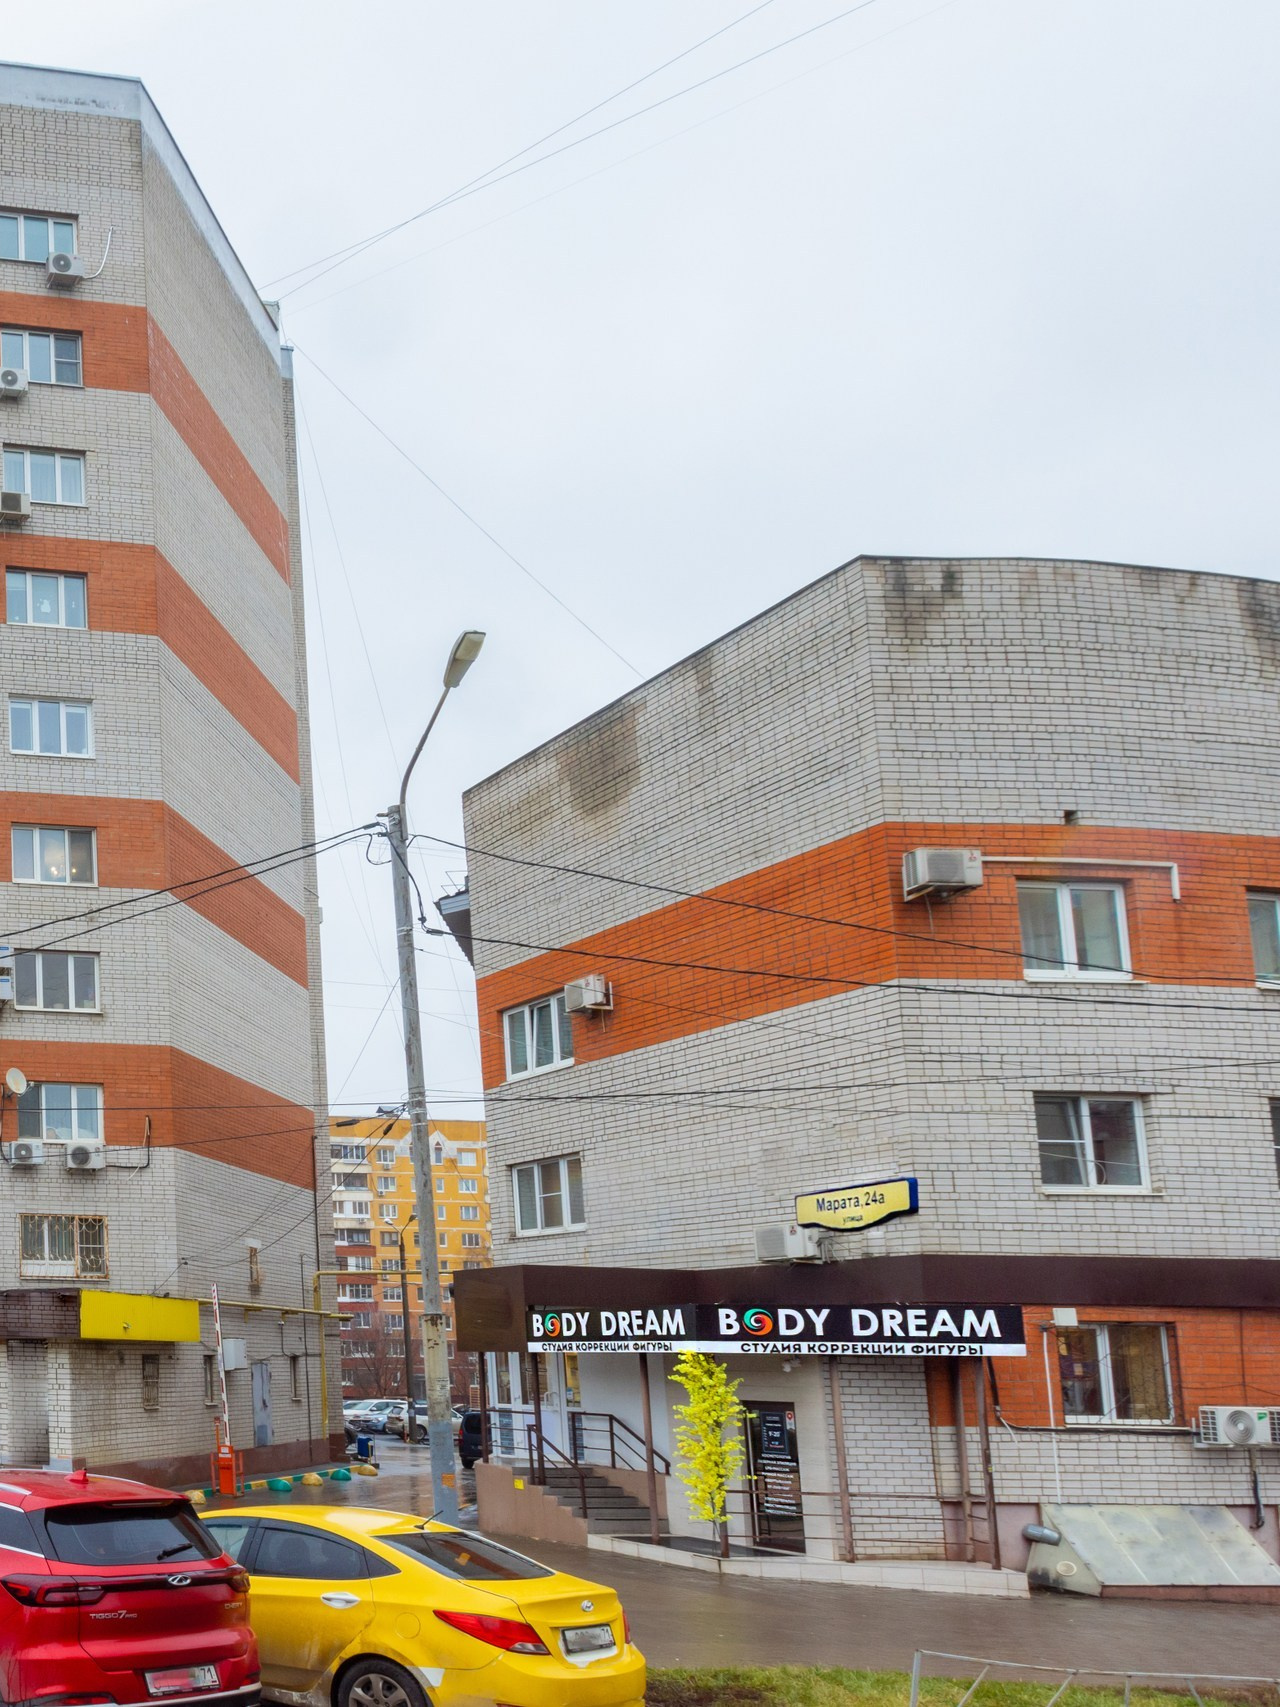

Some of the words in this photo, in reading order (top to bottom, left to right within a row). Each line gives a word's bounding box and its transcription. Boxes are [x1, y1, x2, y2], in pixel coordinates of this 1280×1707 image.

[842, 1214, 864, 1225] улица
[532, 1312, 590, 1337] BODY
[600, 1308, 686, 1337] DREAM
[718, 1308, 830, 1336] BODY
[851, 1308, 1002, 1338] DREAM
[542, 1342, 573, 1352] СТУДИЯ
[575, 1342, 630, 1352] КОРРЕКЦИИ
[633, 1342, 672, 1352] ФИГУРЫ
[740, 1343, 801, 1354] СТУДИЯ
[807, 1343, 906, 1355] КОРРЕКЦИИ
[911, 1344, 984, 1355] ФИГУРЫ
[200, 1667, 214, 1680] 71
